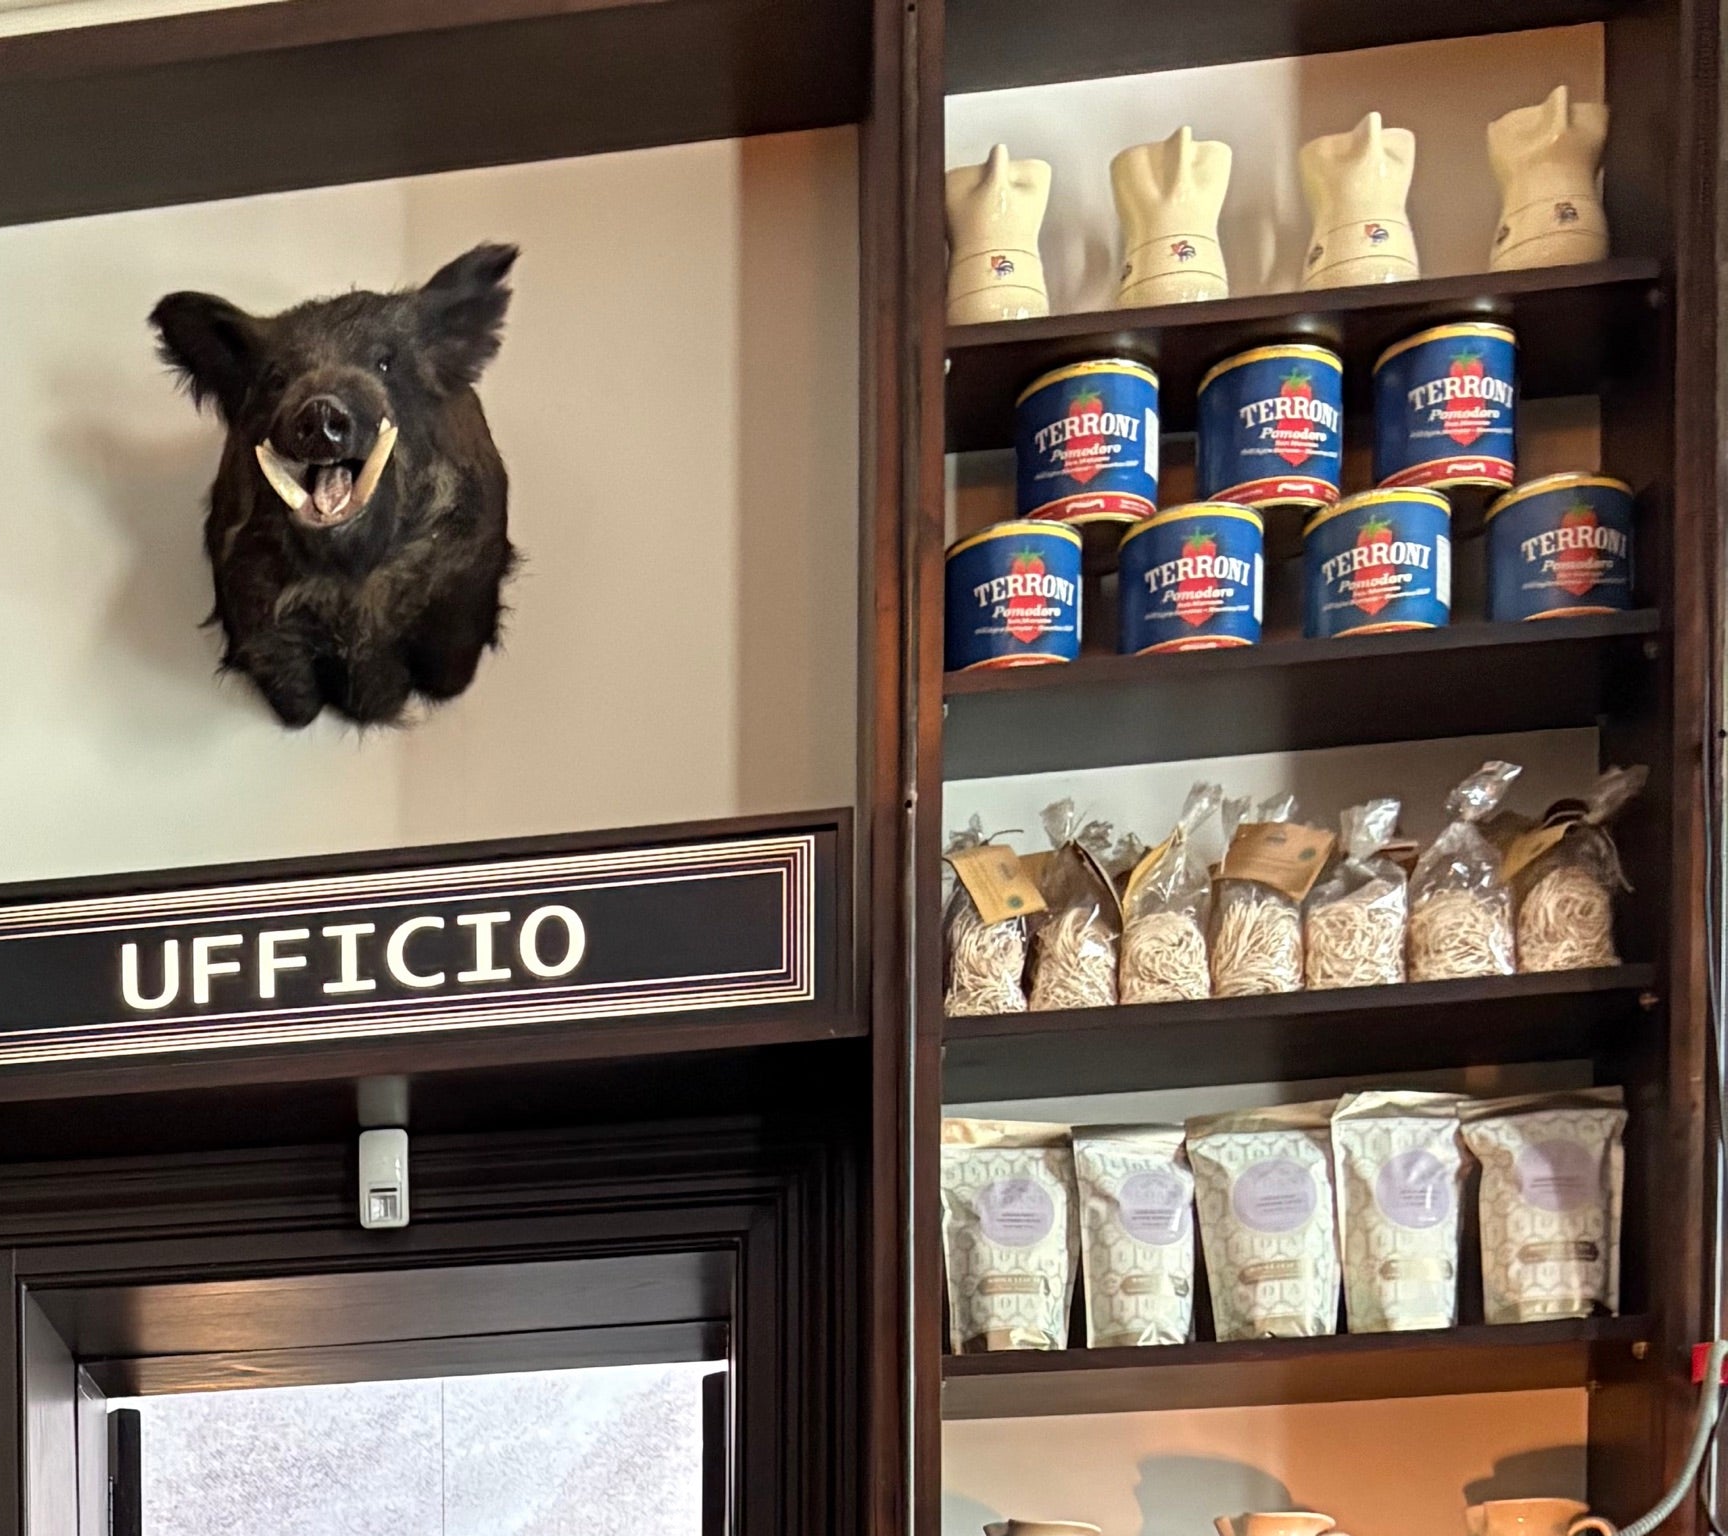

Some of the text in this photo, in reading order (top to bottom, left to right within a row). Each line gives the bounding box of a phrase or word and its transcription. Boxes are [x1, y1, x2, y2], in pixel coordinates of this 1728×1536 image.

[1408, 374, 1513, 410] TERRONI
[1035, 412, 1140, 453] TERRONI
[1240, 397, 1339, 432] TERRONI
[1322, 541, 1431, 584] TERRONI
[1520, 525, 1626, 563] TERRONI
[974, 573, 1074, 607] TERRONI
[1144, 555, 1250, 593] TERRONI
[120, 904, 586, 1010] UFFICIO
